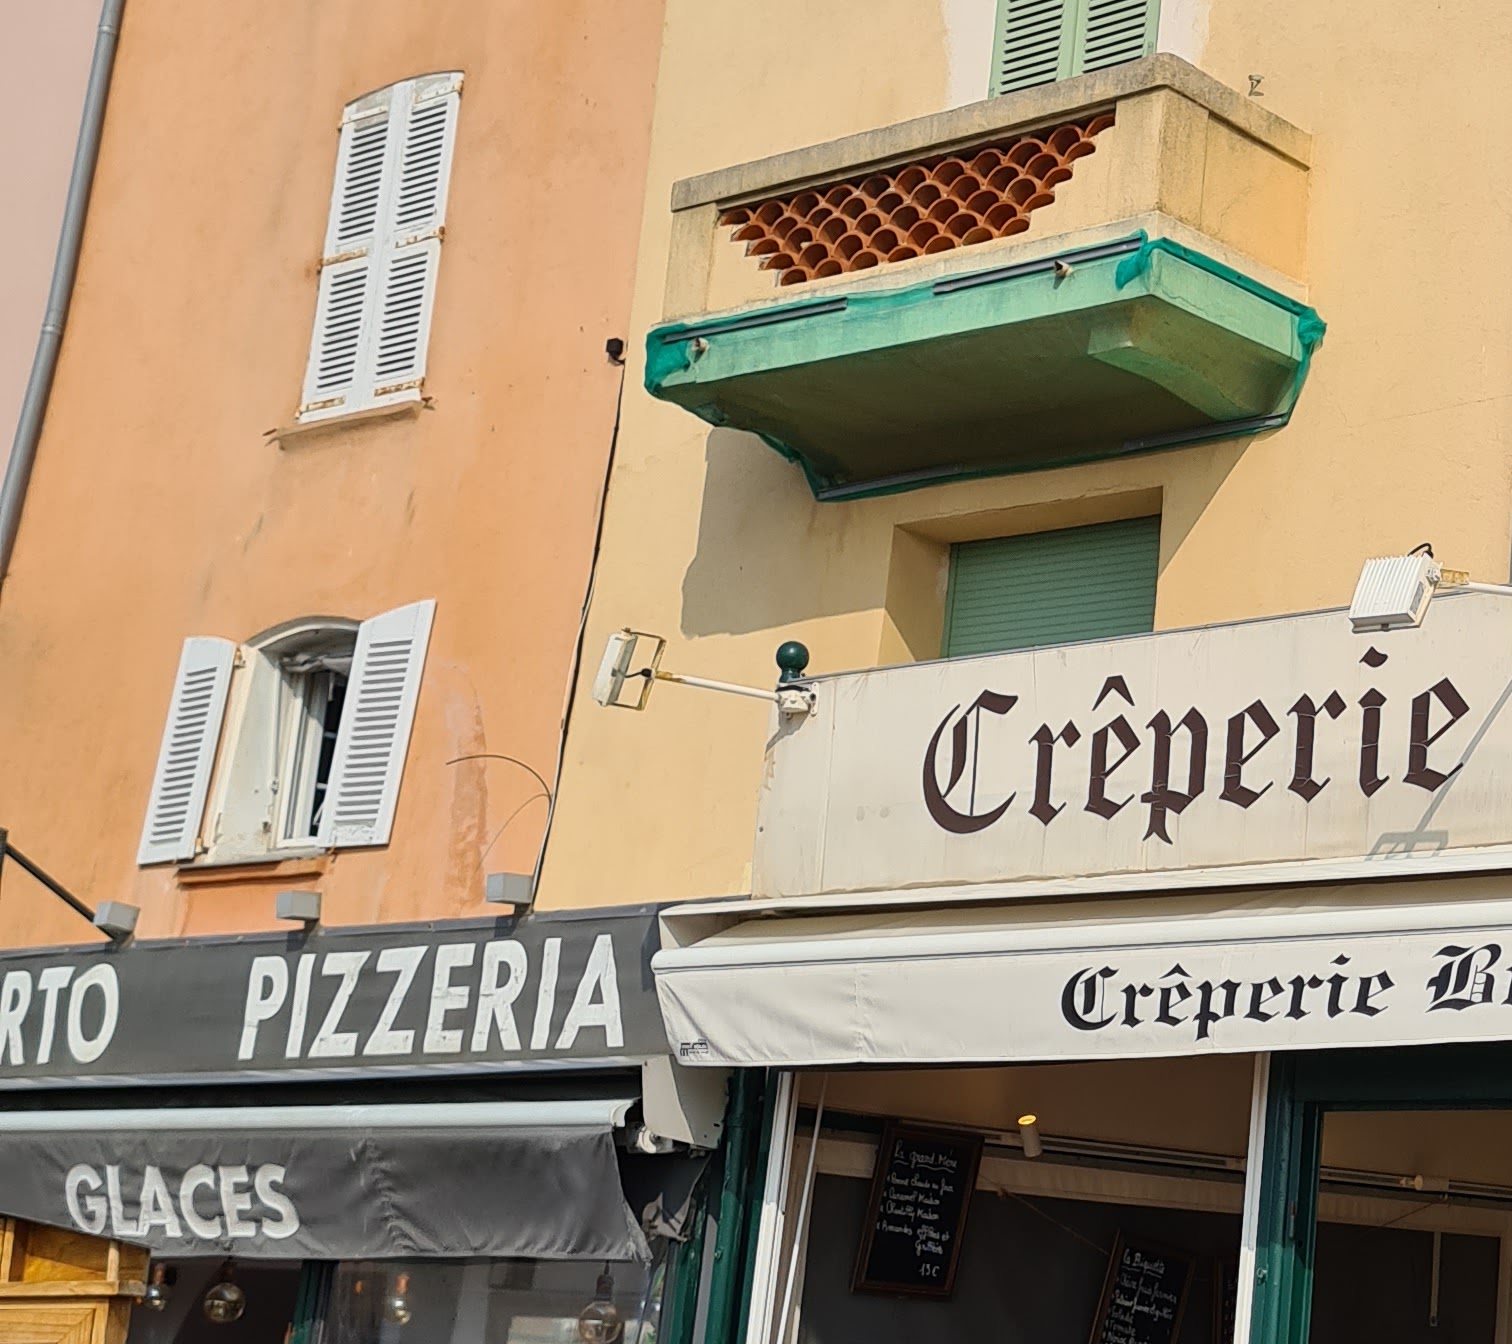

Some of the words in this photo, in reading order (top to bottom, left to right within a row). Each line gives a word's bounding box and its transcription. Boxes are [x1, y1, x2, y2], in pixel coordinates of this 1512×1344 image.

[923, 647, 1471, 844] Crêperie
[238, 934, 624, 1060] PIZZERIA
[1061, 954, 1395, 1040] Crêperie
[65, 1162, 301, 1240] GLACES
